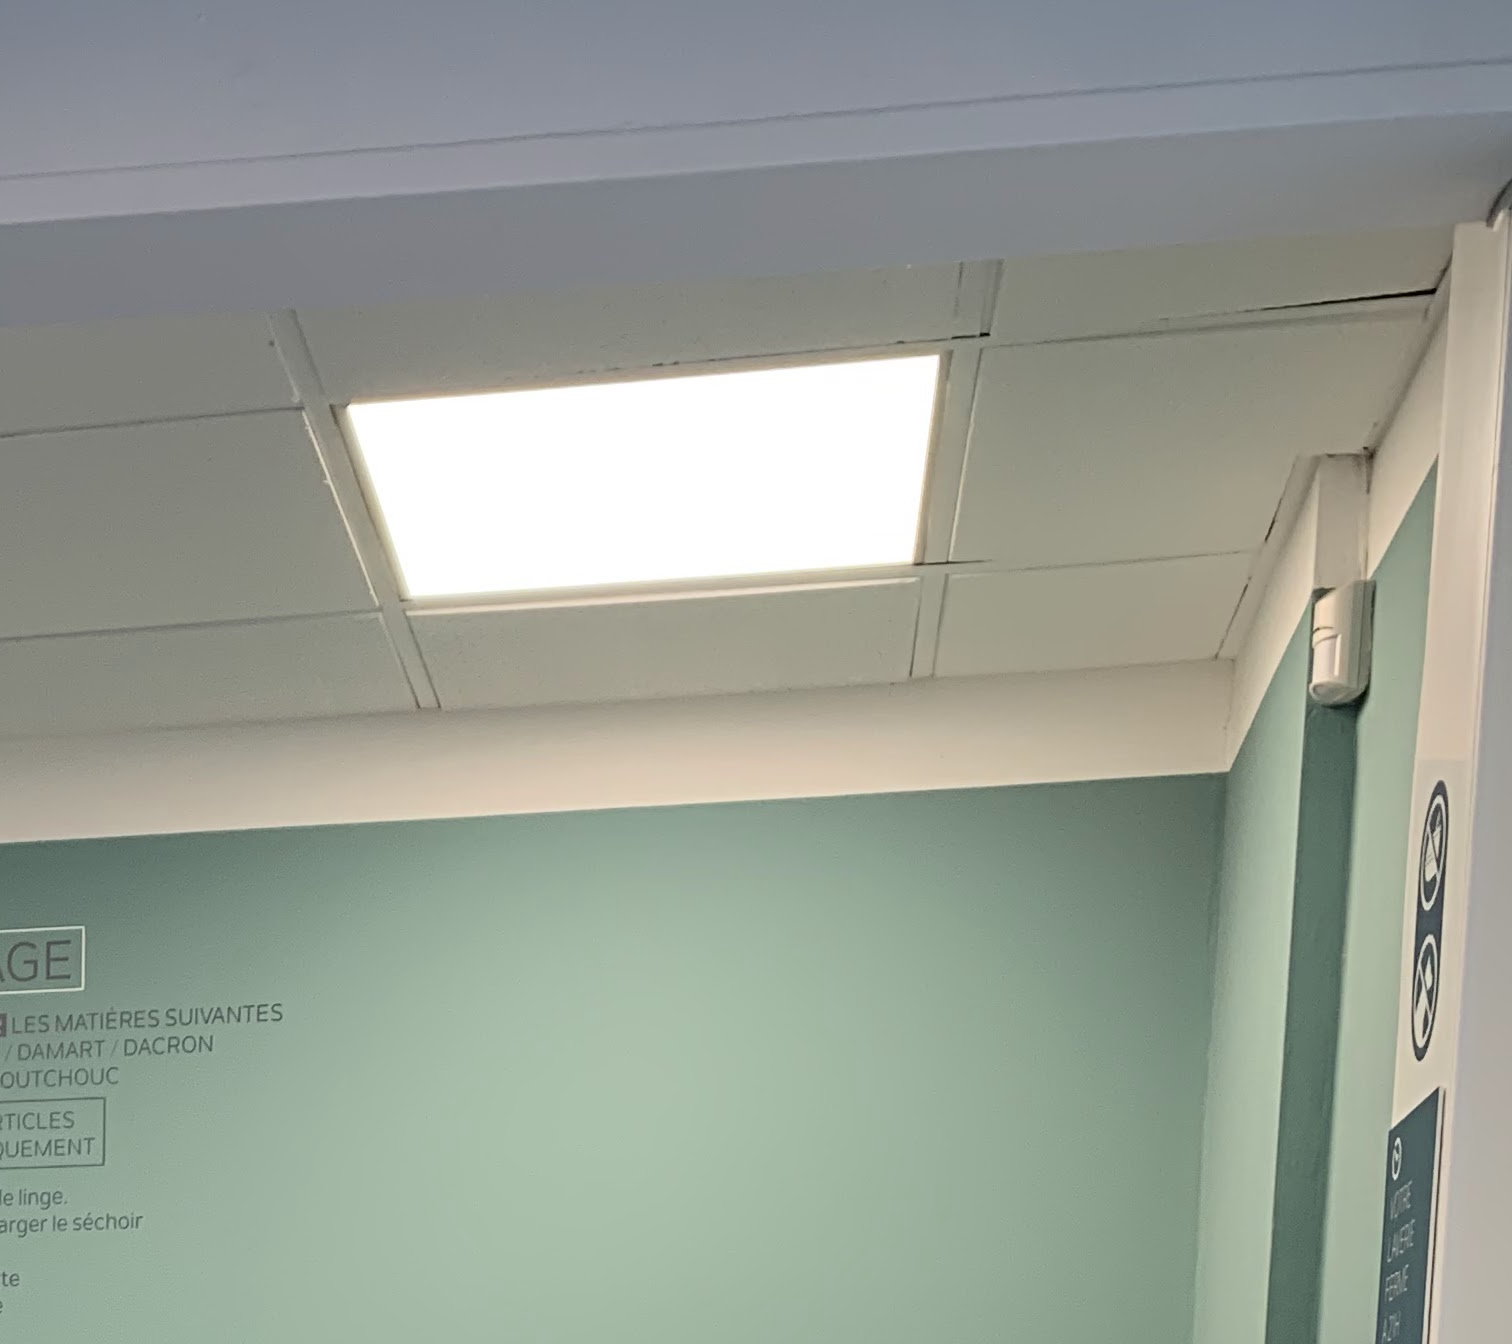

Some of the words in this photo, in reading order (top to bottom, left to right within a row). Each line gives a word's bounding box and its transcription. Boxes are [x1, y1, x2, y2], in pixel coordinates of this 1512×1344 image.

[12, 1014, 50, 1035] LES
[55, 1009, 160, 1032] MATIÈRES
[165, 1002, 284, 1028] SUIVANTES
[17, 1039, 106, 1061] DAMART
[123, 1034, 214, 1057] DACRON
[52, 1214, 68, 1232] le
[72, 1211, 144, 1232] séchoir
